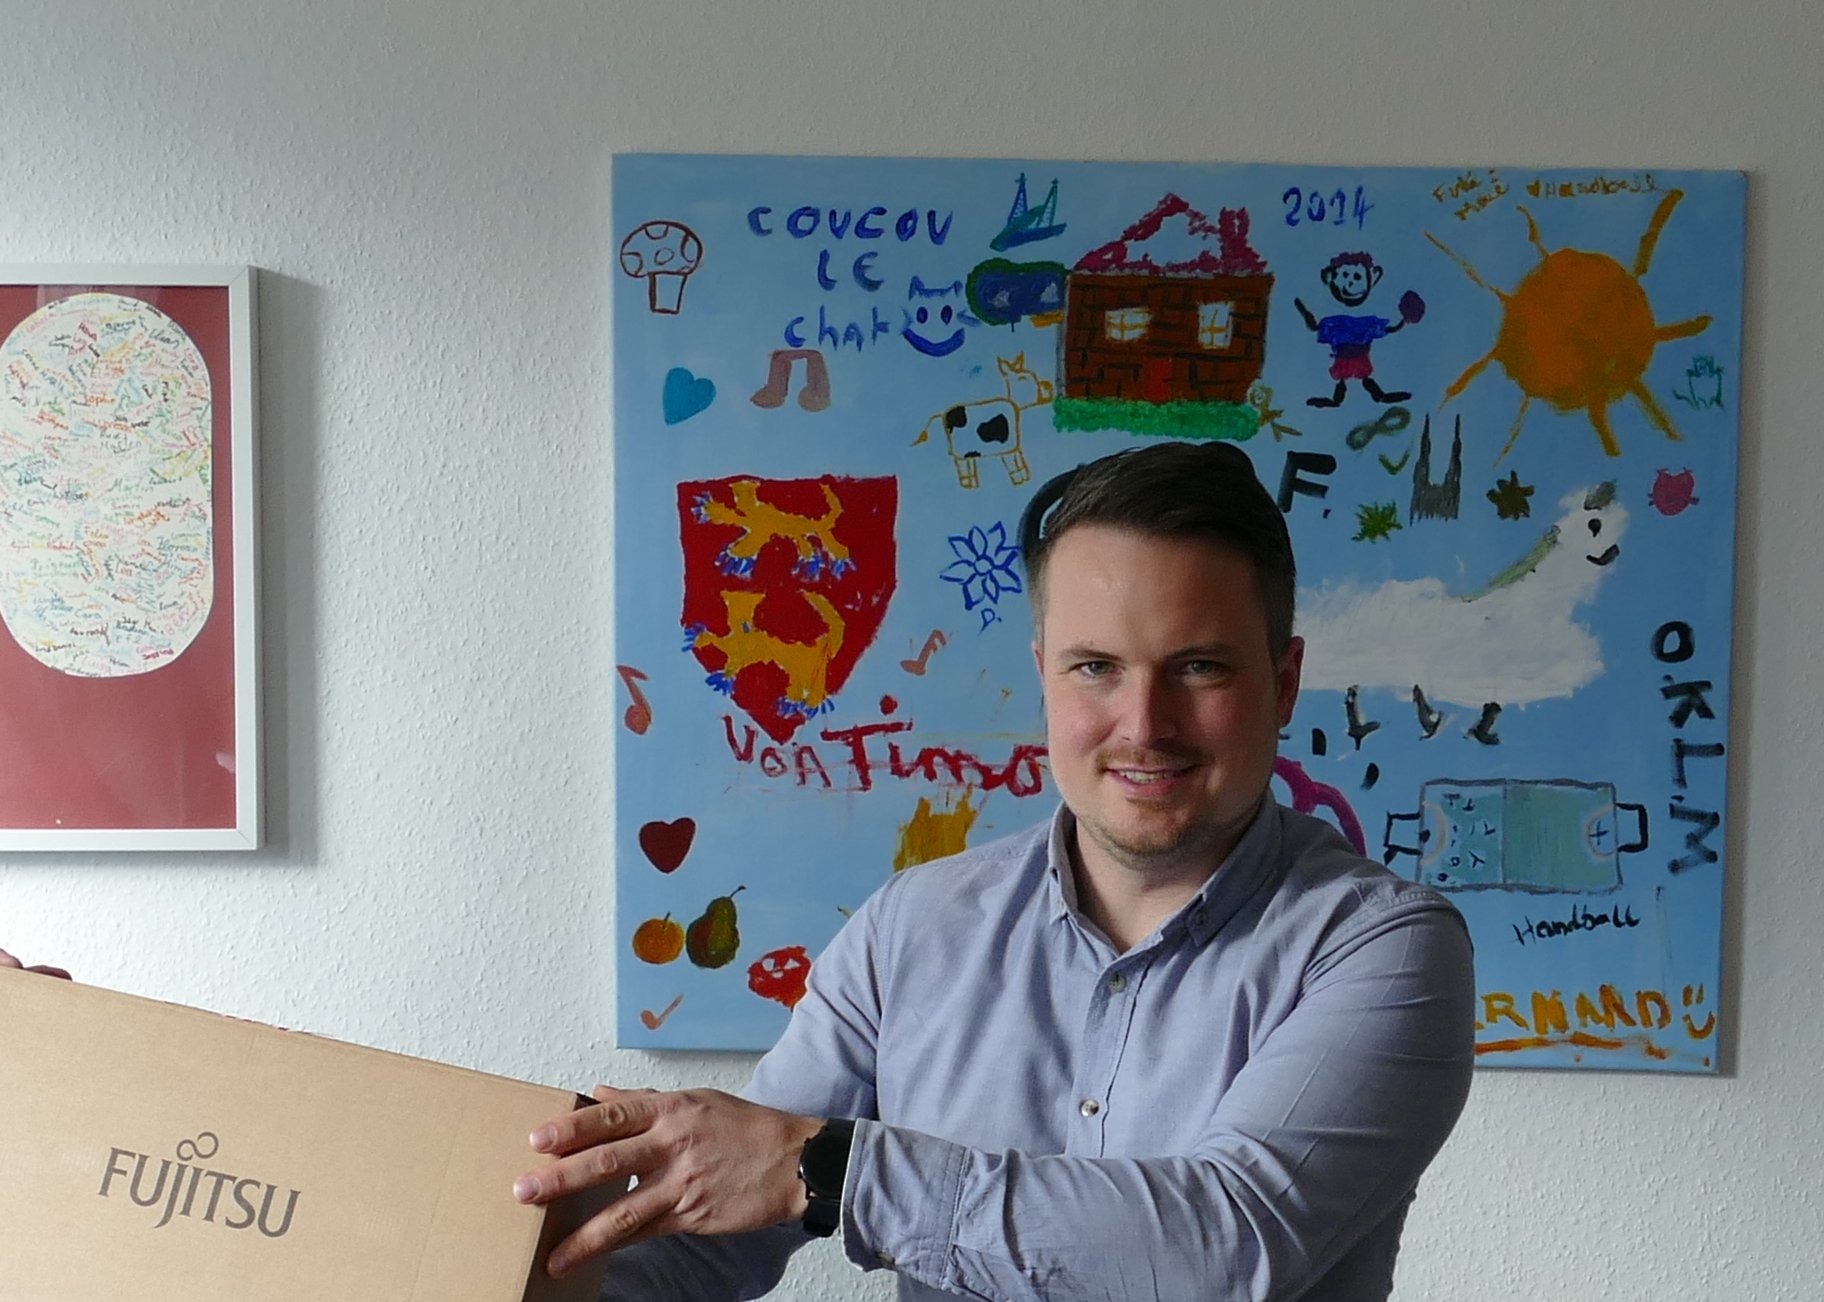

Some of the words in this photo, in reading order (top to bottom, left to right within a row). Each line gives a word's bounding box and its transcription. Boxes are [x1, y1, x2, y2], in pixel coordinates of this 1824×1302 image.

[747, 206, 953, 245] COUCOU
[1282, 184, 1375, 231] 2014
[817, 249, 885, 292] LE
[1474, 983, 1672, 1034] RNARD
[96, 1130, 302, 1239] FUJITSU
